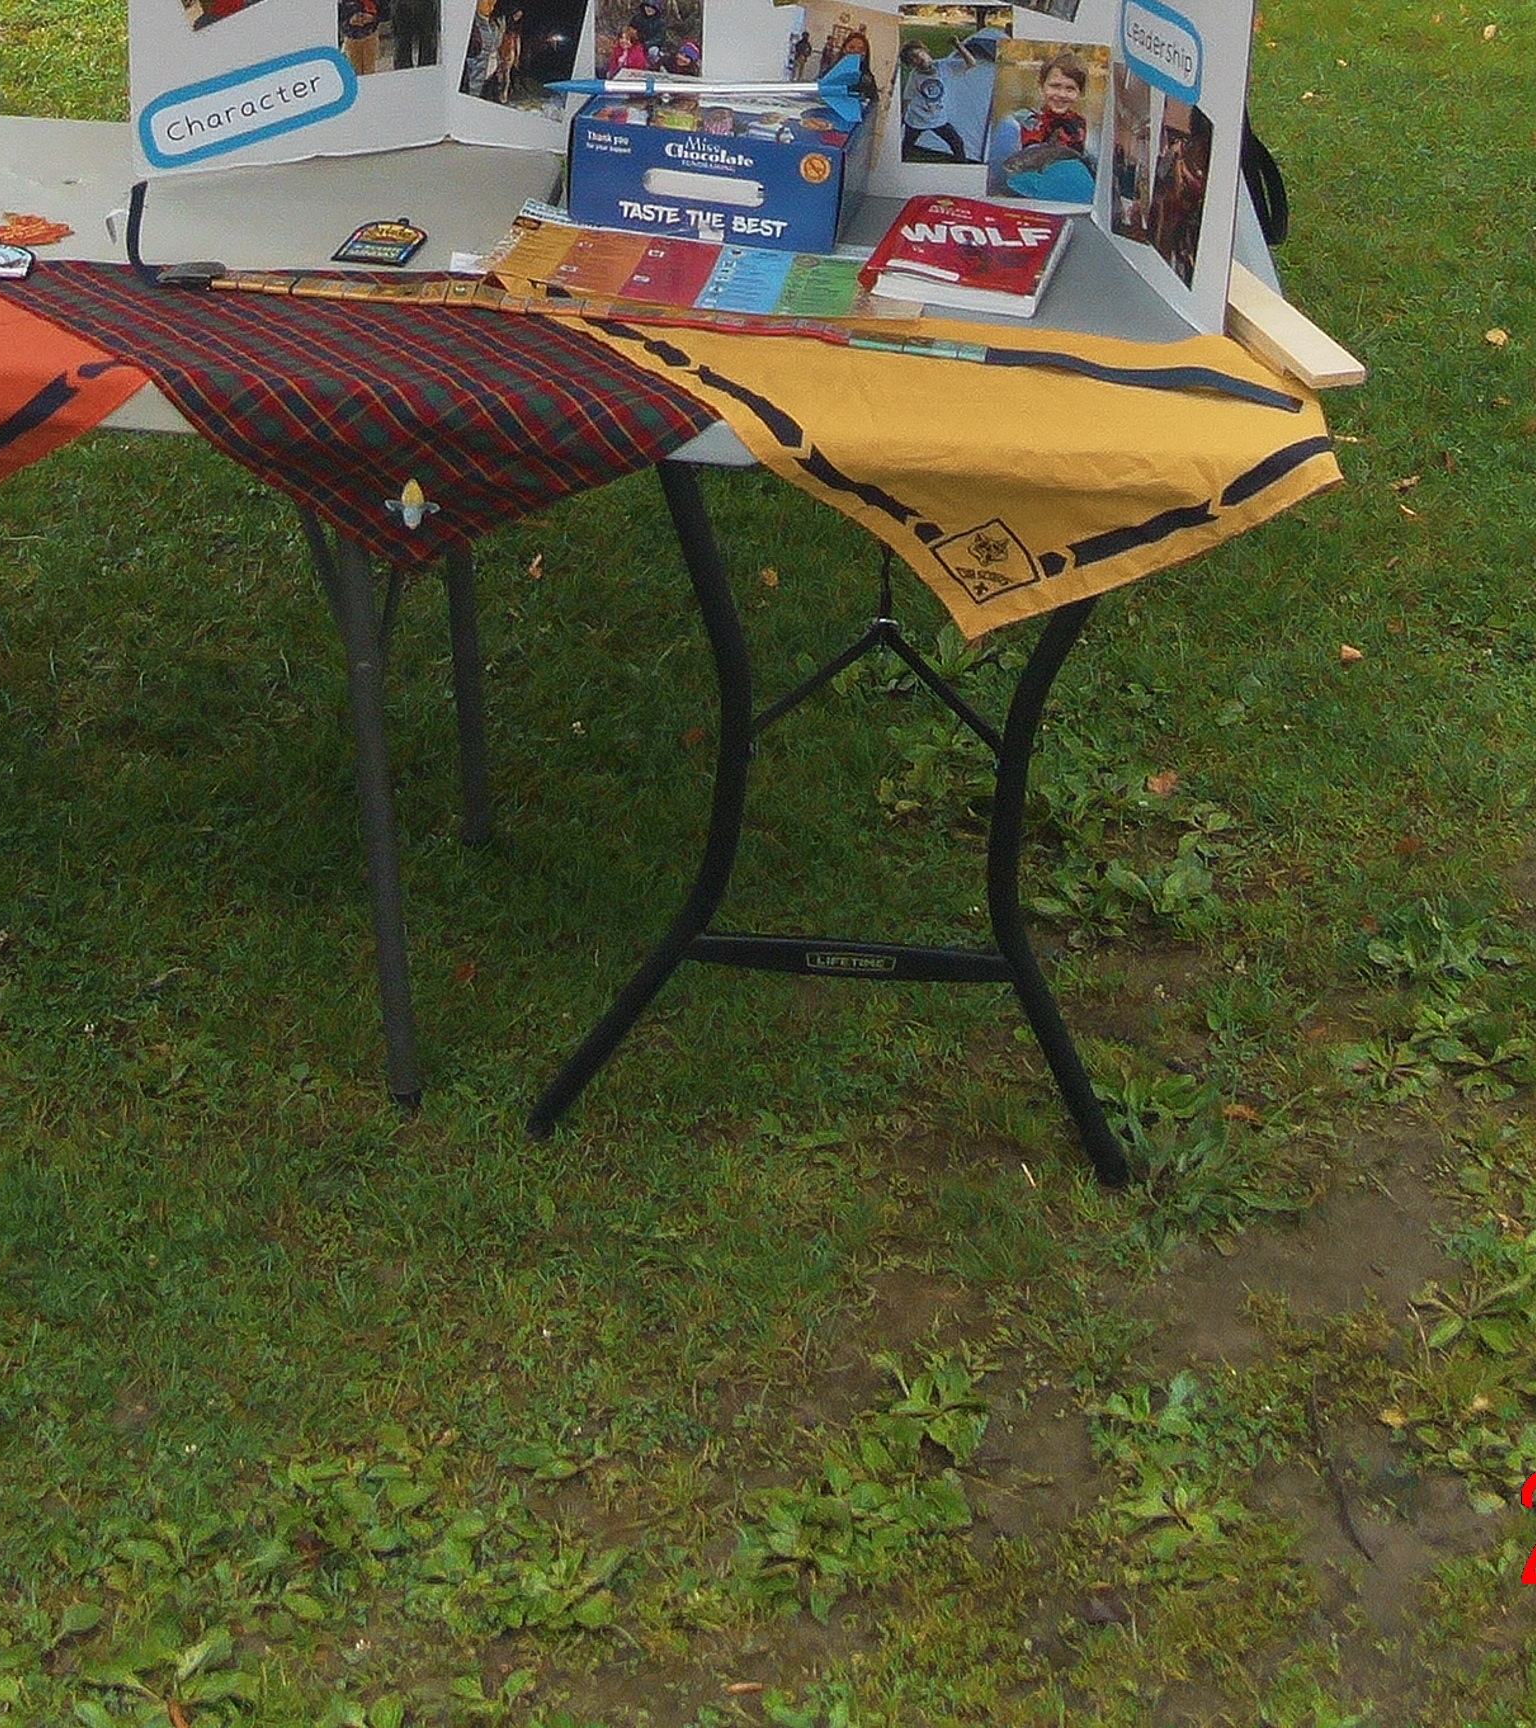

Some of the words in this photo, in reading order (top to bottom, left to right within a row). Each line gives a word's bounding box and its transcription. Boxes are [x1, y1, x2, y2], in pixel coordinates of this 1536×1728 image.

[1126, 21, 1193, 79] Leadership
[166, 73, 323, 143] Character
[587, 129, 613, 143] Thank
[685, 135, 721, 154] Miss
[664, 142, 755, 168] Chocolate
[618, 200, 681, 224] TASTE
[685, 208, 726, 229] THE
[732, 215, 788, 239] BEST
[899, 221, 1053, 248] WOLF
